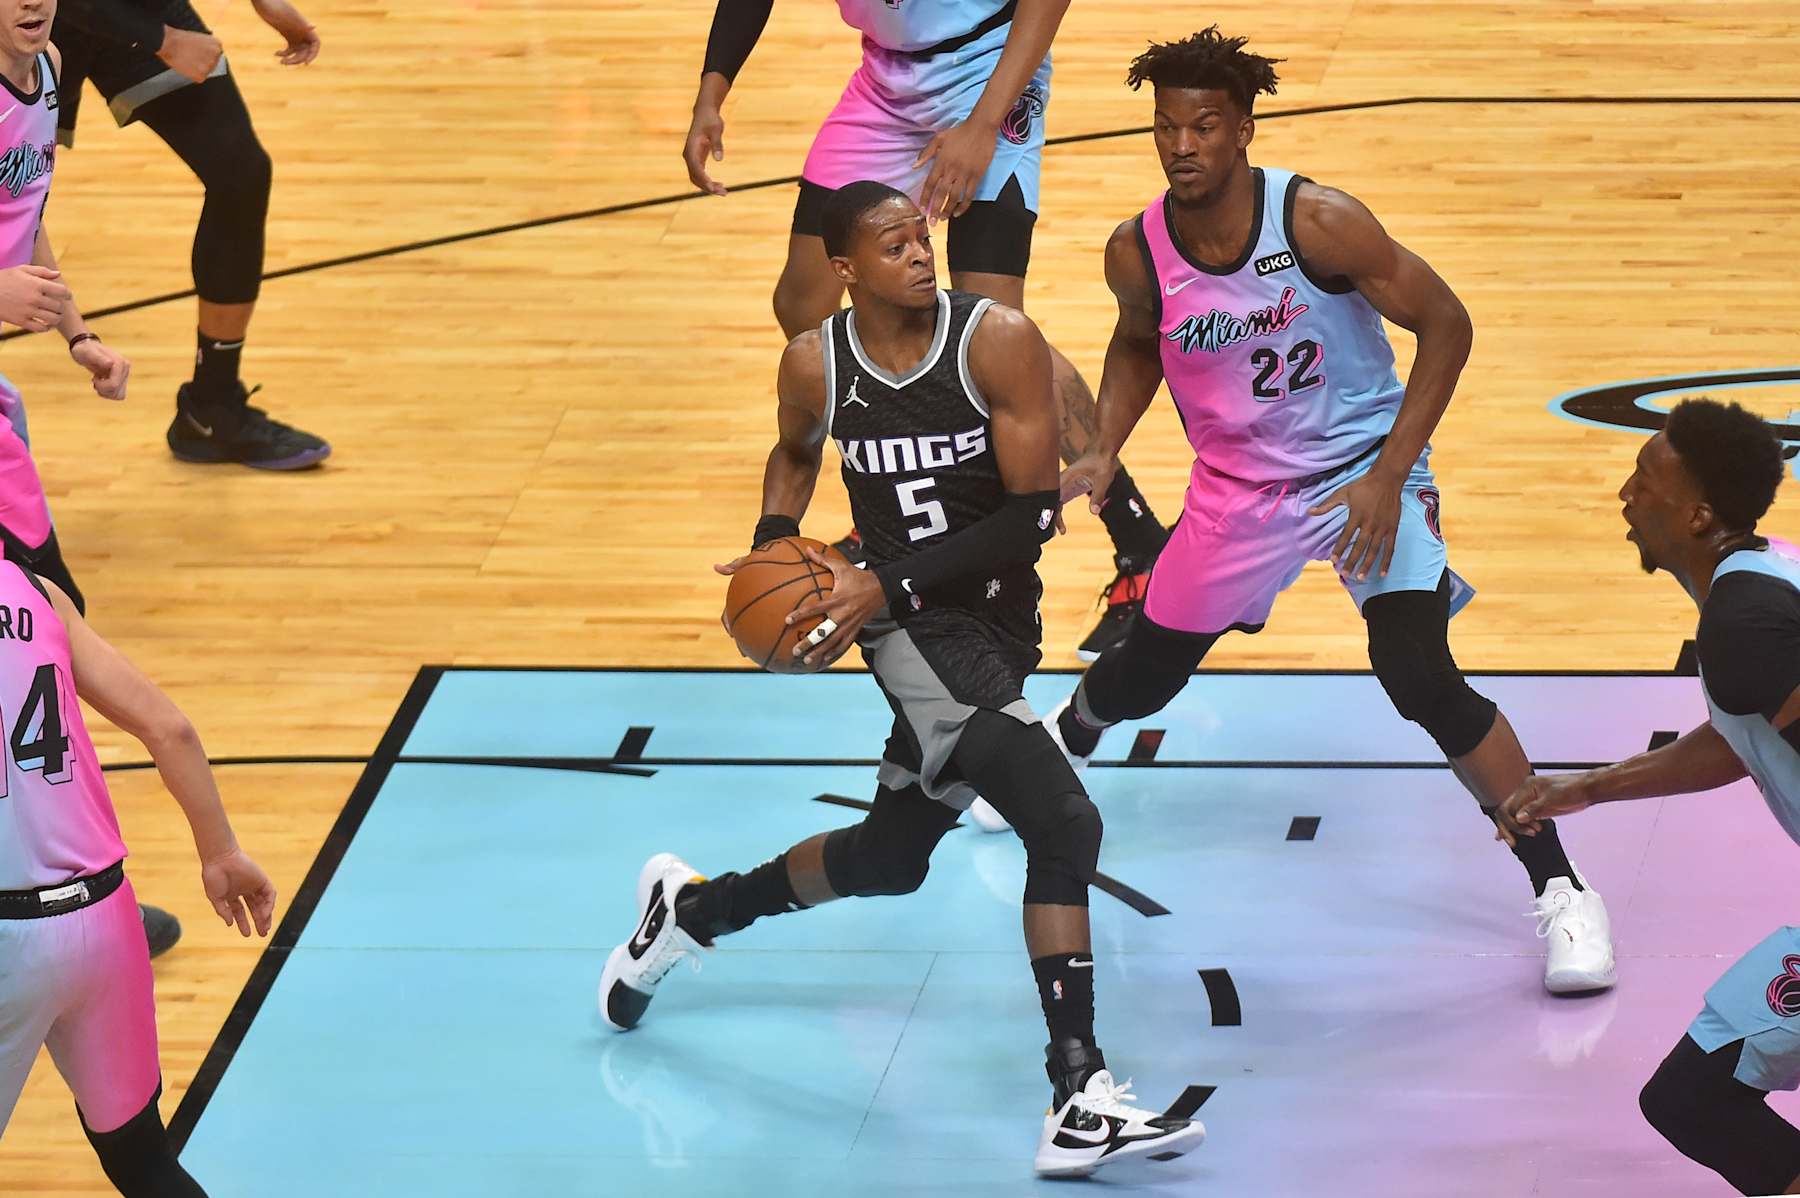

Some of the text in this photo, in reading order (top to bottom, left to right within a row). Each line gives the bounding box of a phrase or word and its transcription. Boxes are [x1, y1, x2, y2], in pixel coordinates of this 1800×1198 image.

[1168, 286, 1309, 353] Miami
[1251, 339, 1325, 402] 22
[835, 426, 987, 473] KINGS
[895, 477, 949, 542] 5
[0, 663, 77, 799] 4
